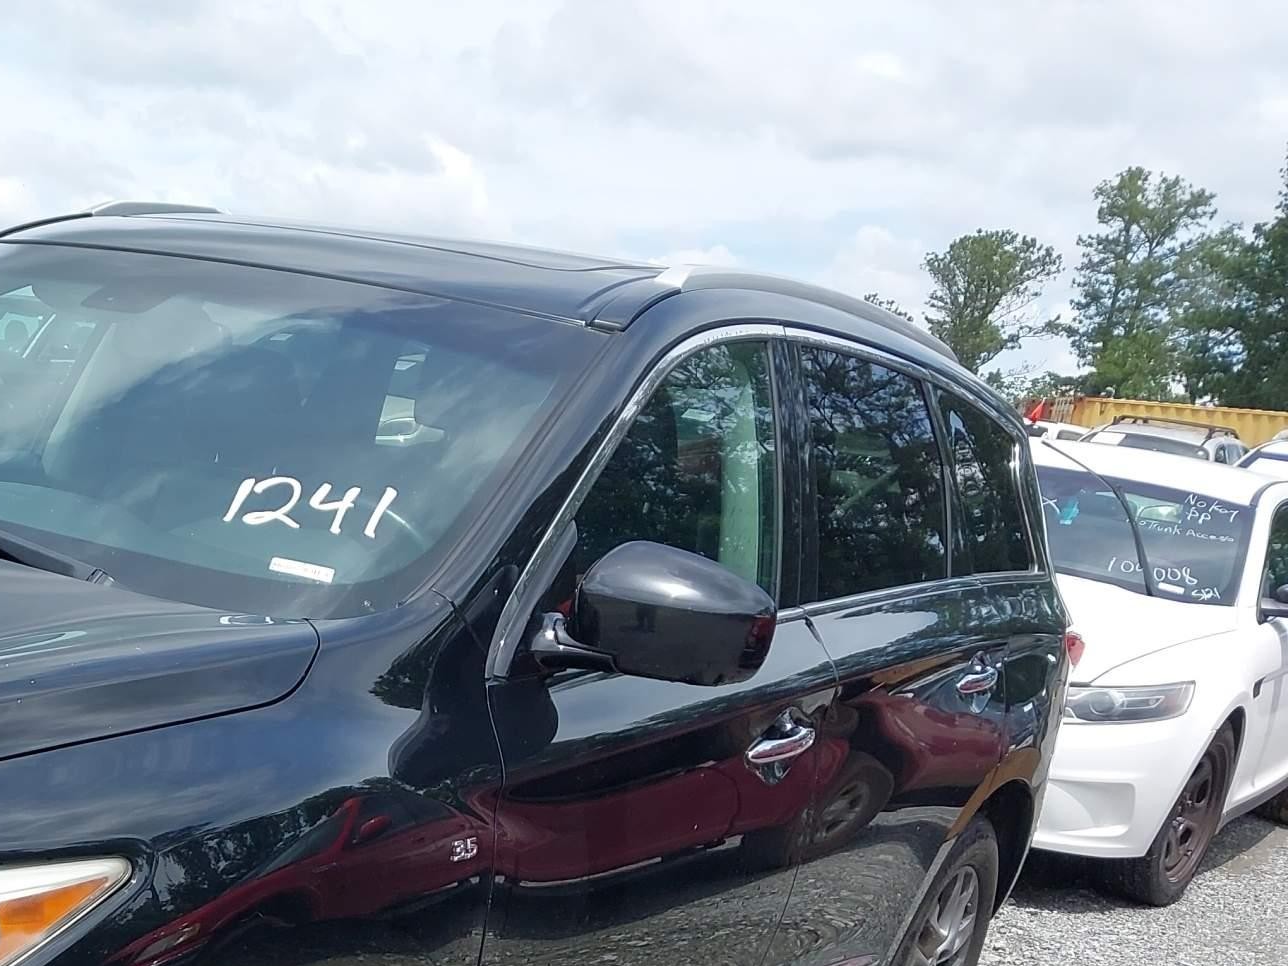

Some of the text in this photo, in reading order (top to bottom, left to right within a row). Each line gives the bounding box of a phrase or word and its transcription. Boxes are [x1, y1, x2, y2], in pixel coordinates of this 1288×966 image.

[222, 476, 398, 539] 1241
[1184, 493, 1207, 508] No
[1148, 520, 1182, 535] Trunk
